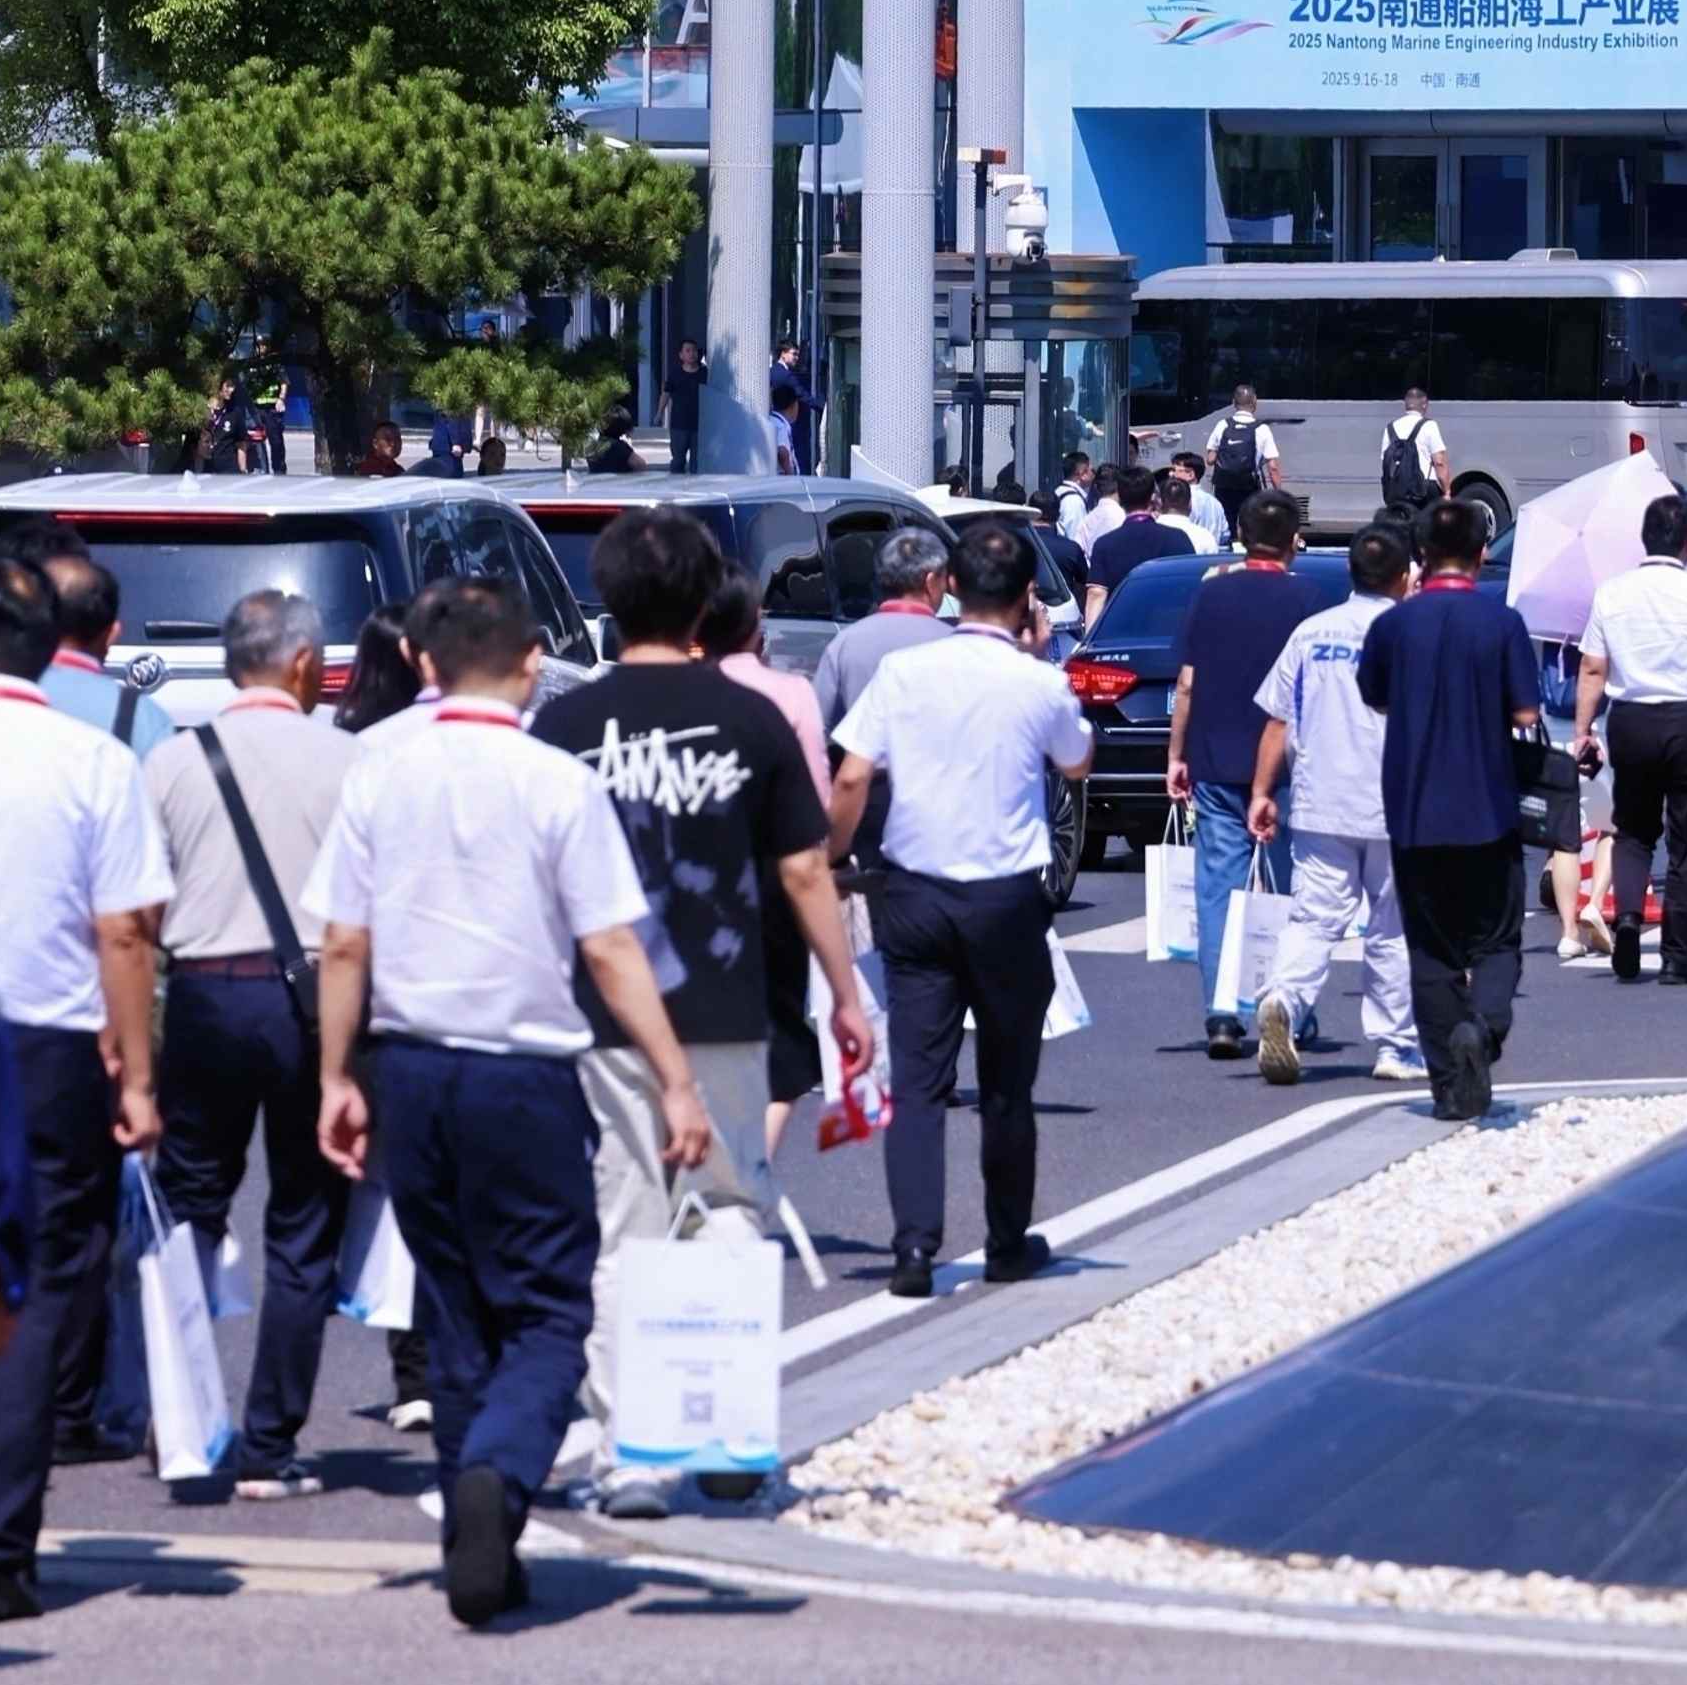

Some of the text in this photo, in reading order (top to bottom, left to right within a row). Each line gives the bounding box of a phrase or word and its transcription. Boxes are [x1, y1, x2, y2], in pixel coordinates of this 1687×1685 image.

[1288, 32, 1679, 53] 2025 Nantong Marine Engineering Industry Exhibition
[1321, 71, 1399, 87] 2025.9.16-18
